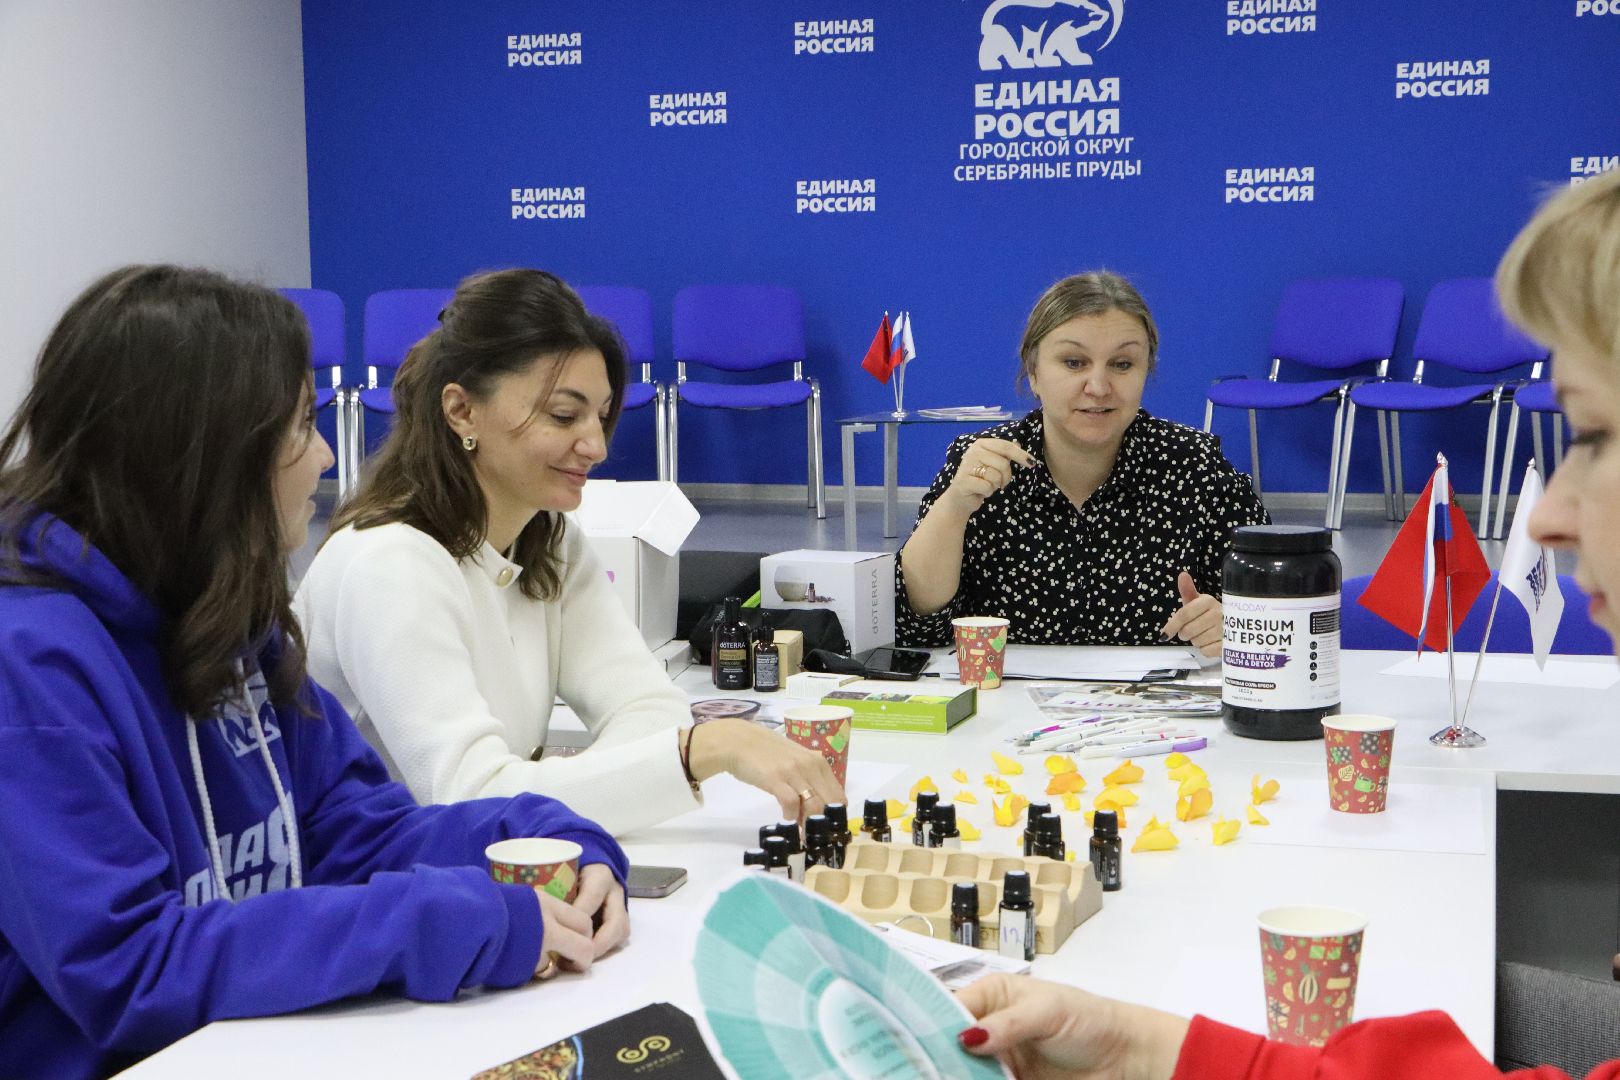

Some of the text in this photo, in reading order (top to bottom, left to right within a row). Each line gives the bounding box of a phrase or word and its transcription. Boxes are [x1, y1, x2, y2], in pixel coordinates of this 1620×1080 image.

[1227, 0, 1316, 17] ЕДИНАЯ
[795, 19, 873, 37] ЕДИНАЯ
[1227, 15, 1316, 36] РОССИЯ
[508, 33, 581, 50] ЕДИНАЯ
[795, 36, 873, 55] РОССИЯ
[508, 49, 581, 67] РОССИЯ
[1396, 60, 1489, 79] ЕДИНАЯ
[975, 78, 1119, 109] ЕДИНАЯ
[1396, 79, 1489, 98] РОССИЯ
[650, 92, 726, 109] ЕДИНАЯ
[650, 108, 727, 126] РОССИЯ
[975, 108, 1119, 139] РОССИЯ
[959, 136, 1134, 160] ГОРОДСКОЙ ОКРУГ
[954, 159, 1141, 181] СЕРЕБРЯНЫЕ ПРУДЫ
[1226, 167, 1314, 185] ЕДИНАЯ
[512, 187, 585, 203] ЕДИНАЯ
[797, 179, 875, 196] ЕДИНАЯ
[1226, 185, 1314, 203] РОССИЯ
[512, 203, 585, 219] РОССИЯ
[797, 196, 875, 213] РОССИЯ
[1223, 629, 1292, 646] ALT EPSOM
[1246, 653, 1276, 661] RELIEVE
[1250, 660, 1275, 668] DETOX
